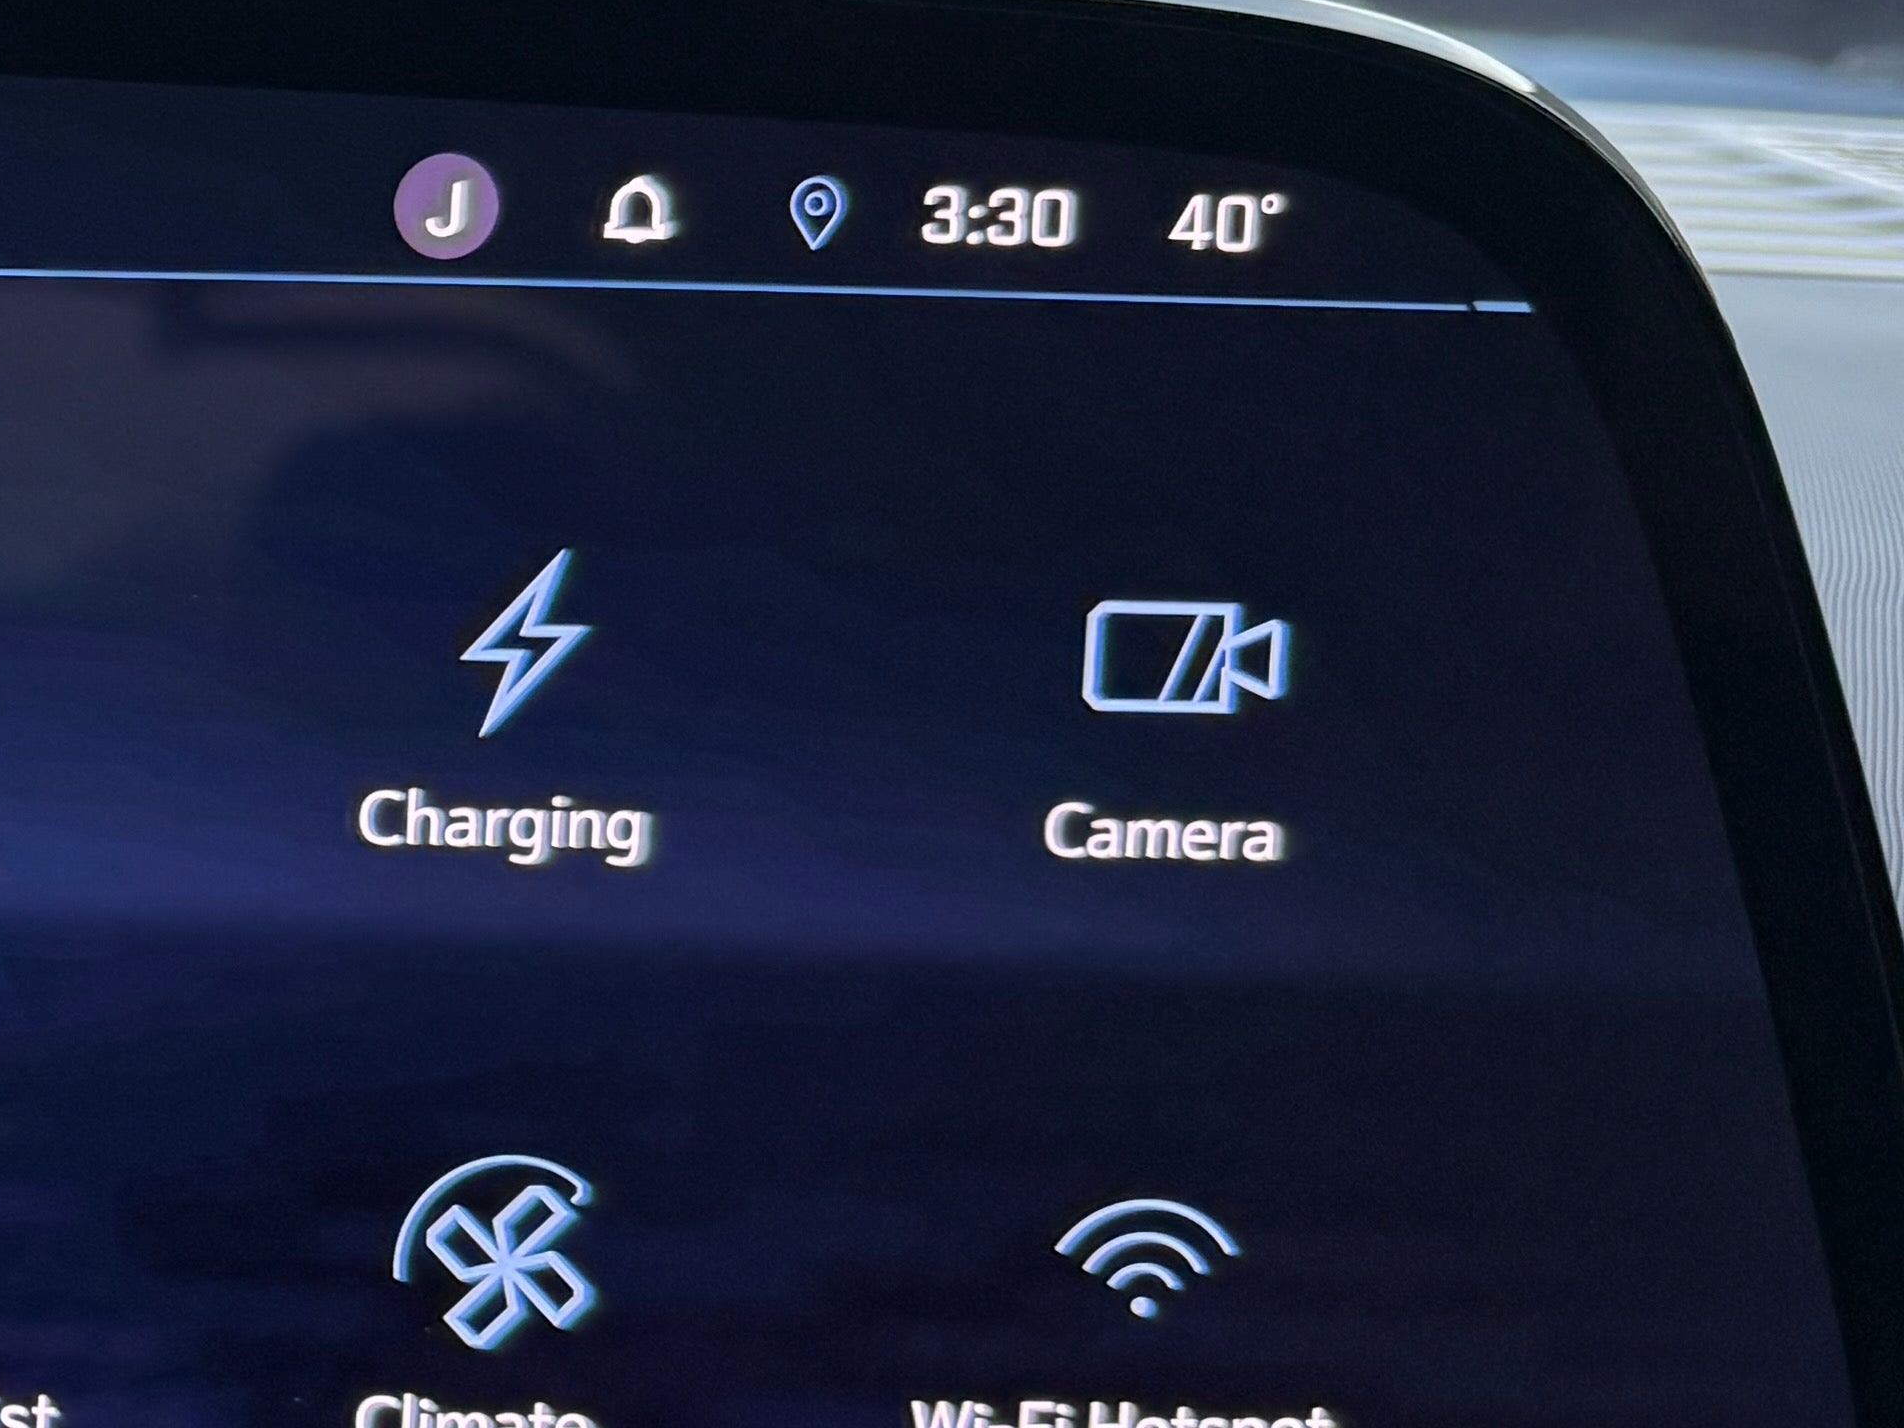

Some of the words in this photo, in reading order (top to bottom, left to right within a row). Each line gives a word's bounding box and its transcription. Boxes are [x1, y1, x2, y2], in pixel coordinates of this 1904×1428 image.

[426, 181, 467, 237] J
[922, 186, 1076, 247] 3:30
[359, 788, 650, 867] Charging
[1045, 802, 1282, 861] Camera
